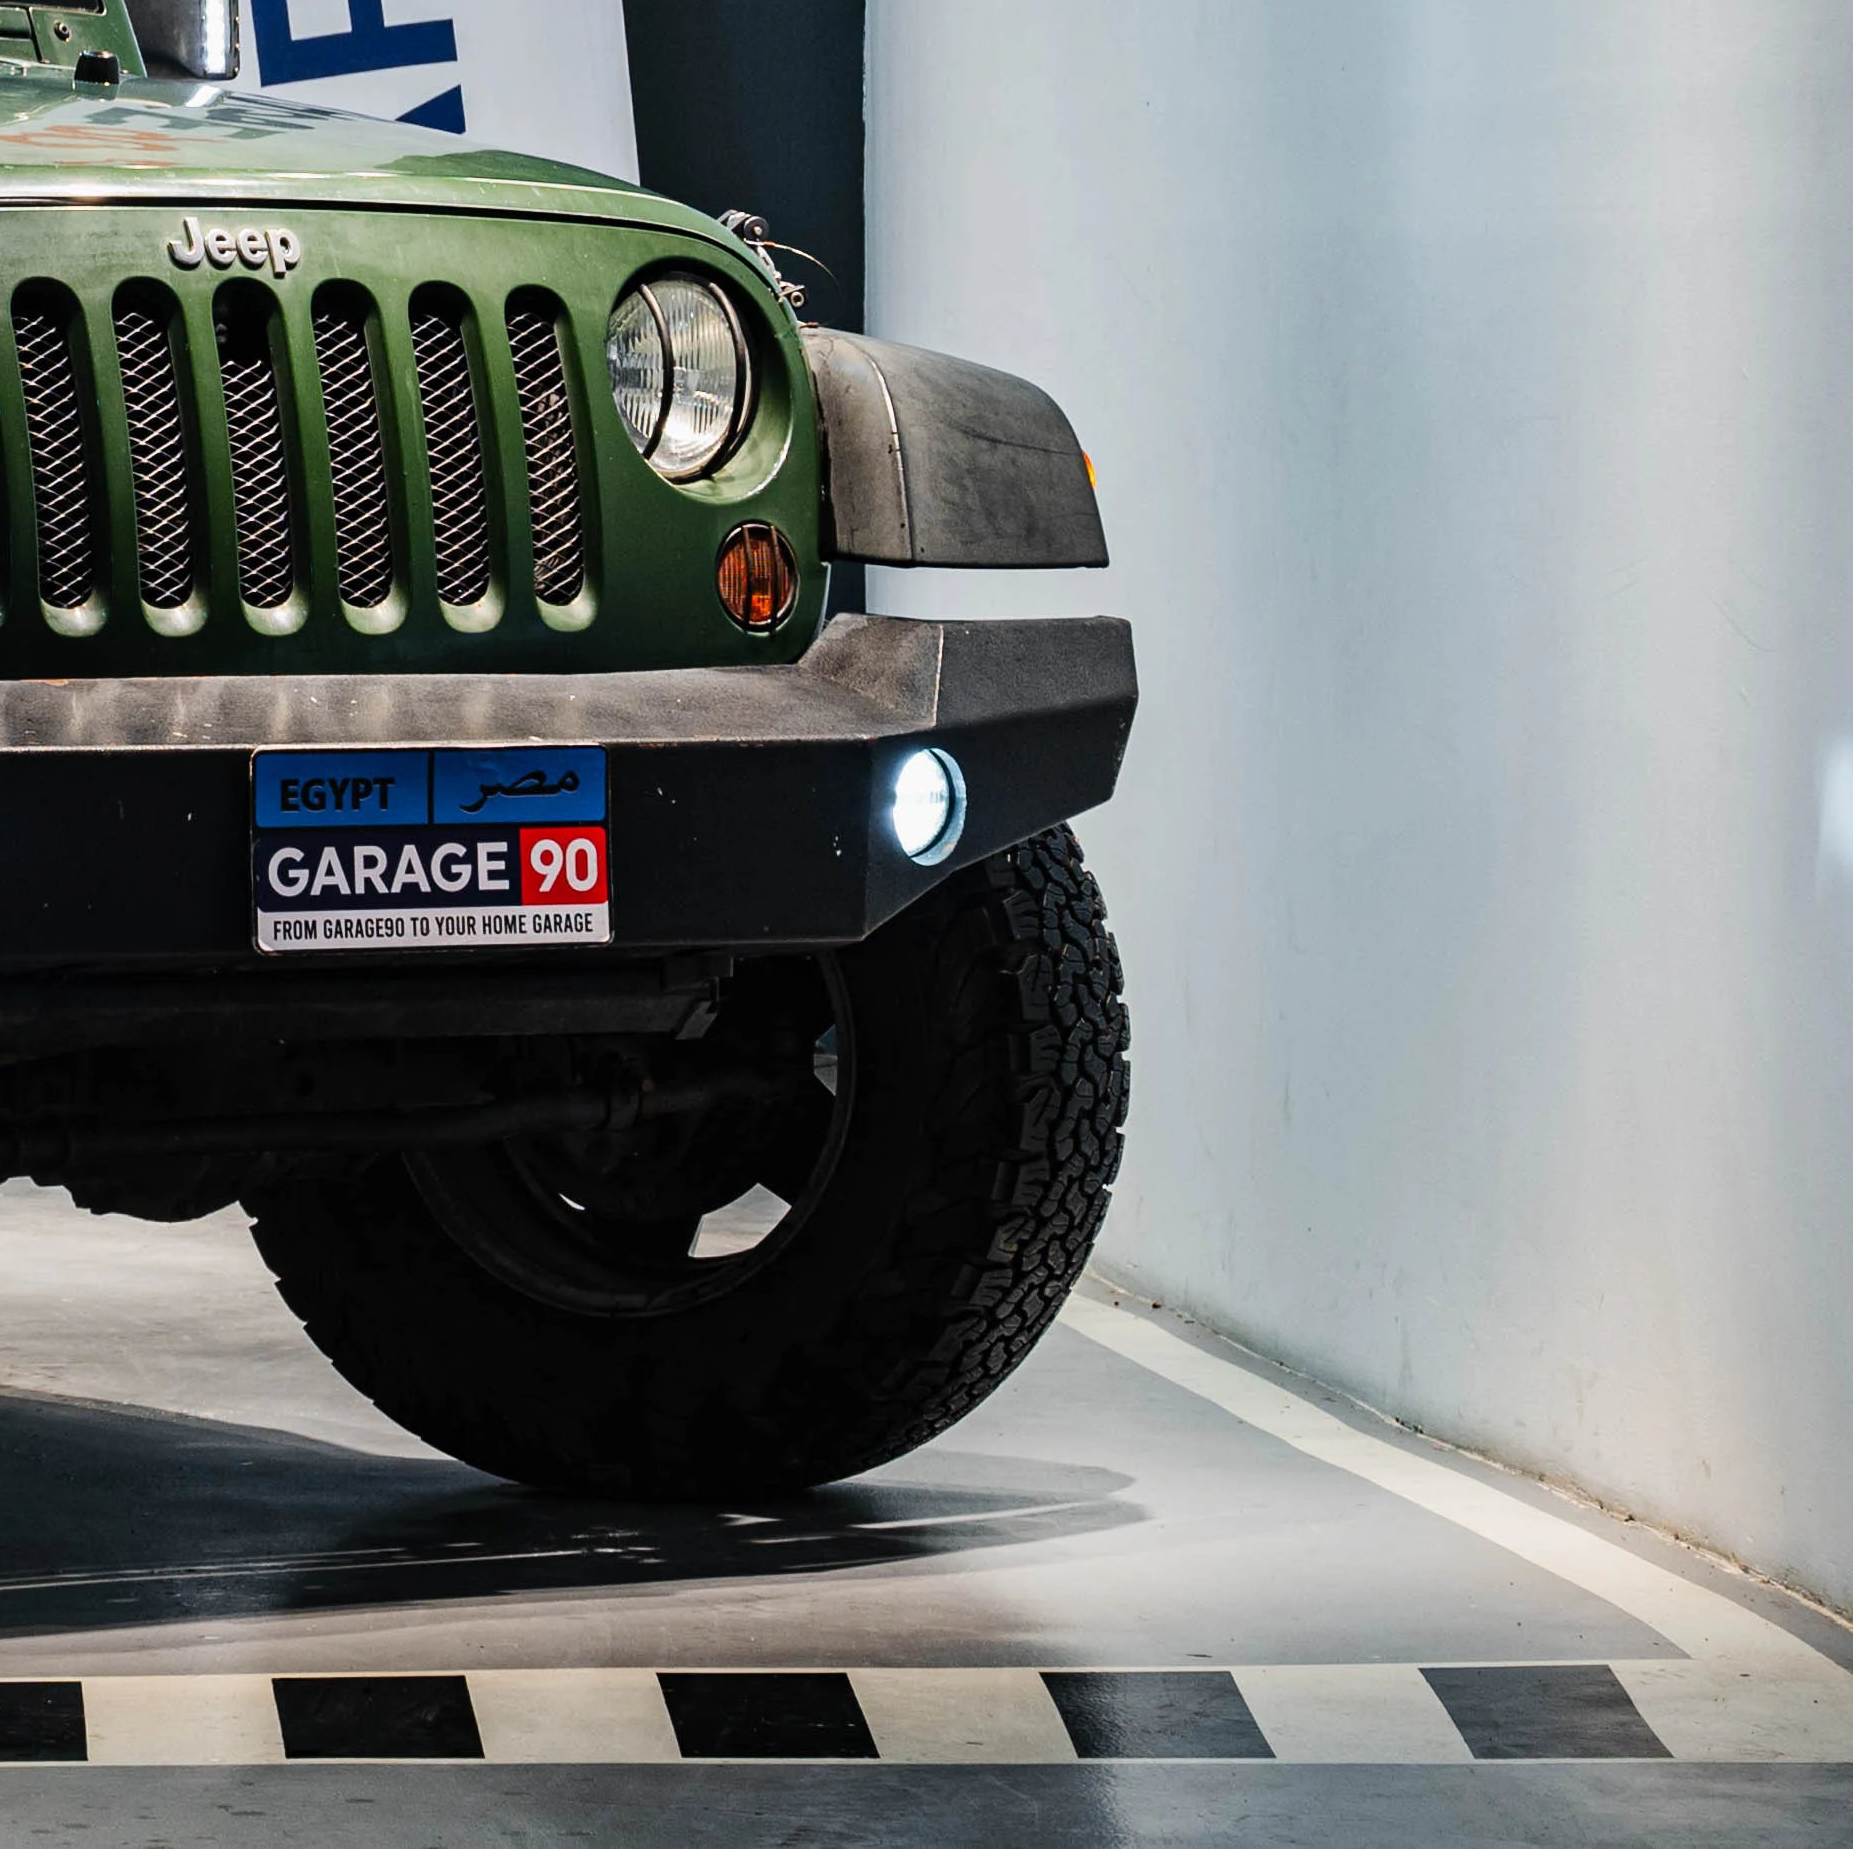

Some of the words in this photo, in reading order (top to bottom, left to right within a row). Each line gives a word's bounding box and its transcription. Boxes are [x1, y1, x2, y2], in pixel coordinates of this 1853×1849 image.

[167, 216, 302, 278] Jeep
[280, 778, 395, 812] EGYPT
[459, 768, 581, 813] مصر
[268, 841, 510, 898] GARAGE
[529, 838, 598, 893] 90
[273, 919, 318, 941] FROM
[323, 916, 405, 939] GARAGE90
[411, 916, 431, 937] TO
[435, 915, 477, 937] YOUR
[482, 914, 528, 935] HOME
[532, 912, 593, 934] GARAGE
